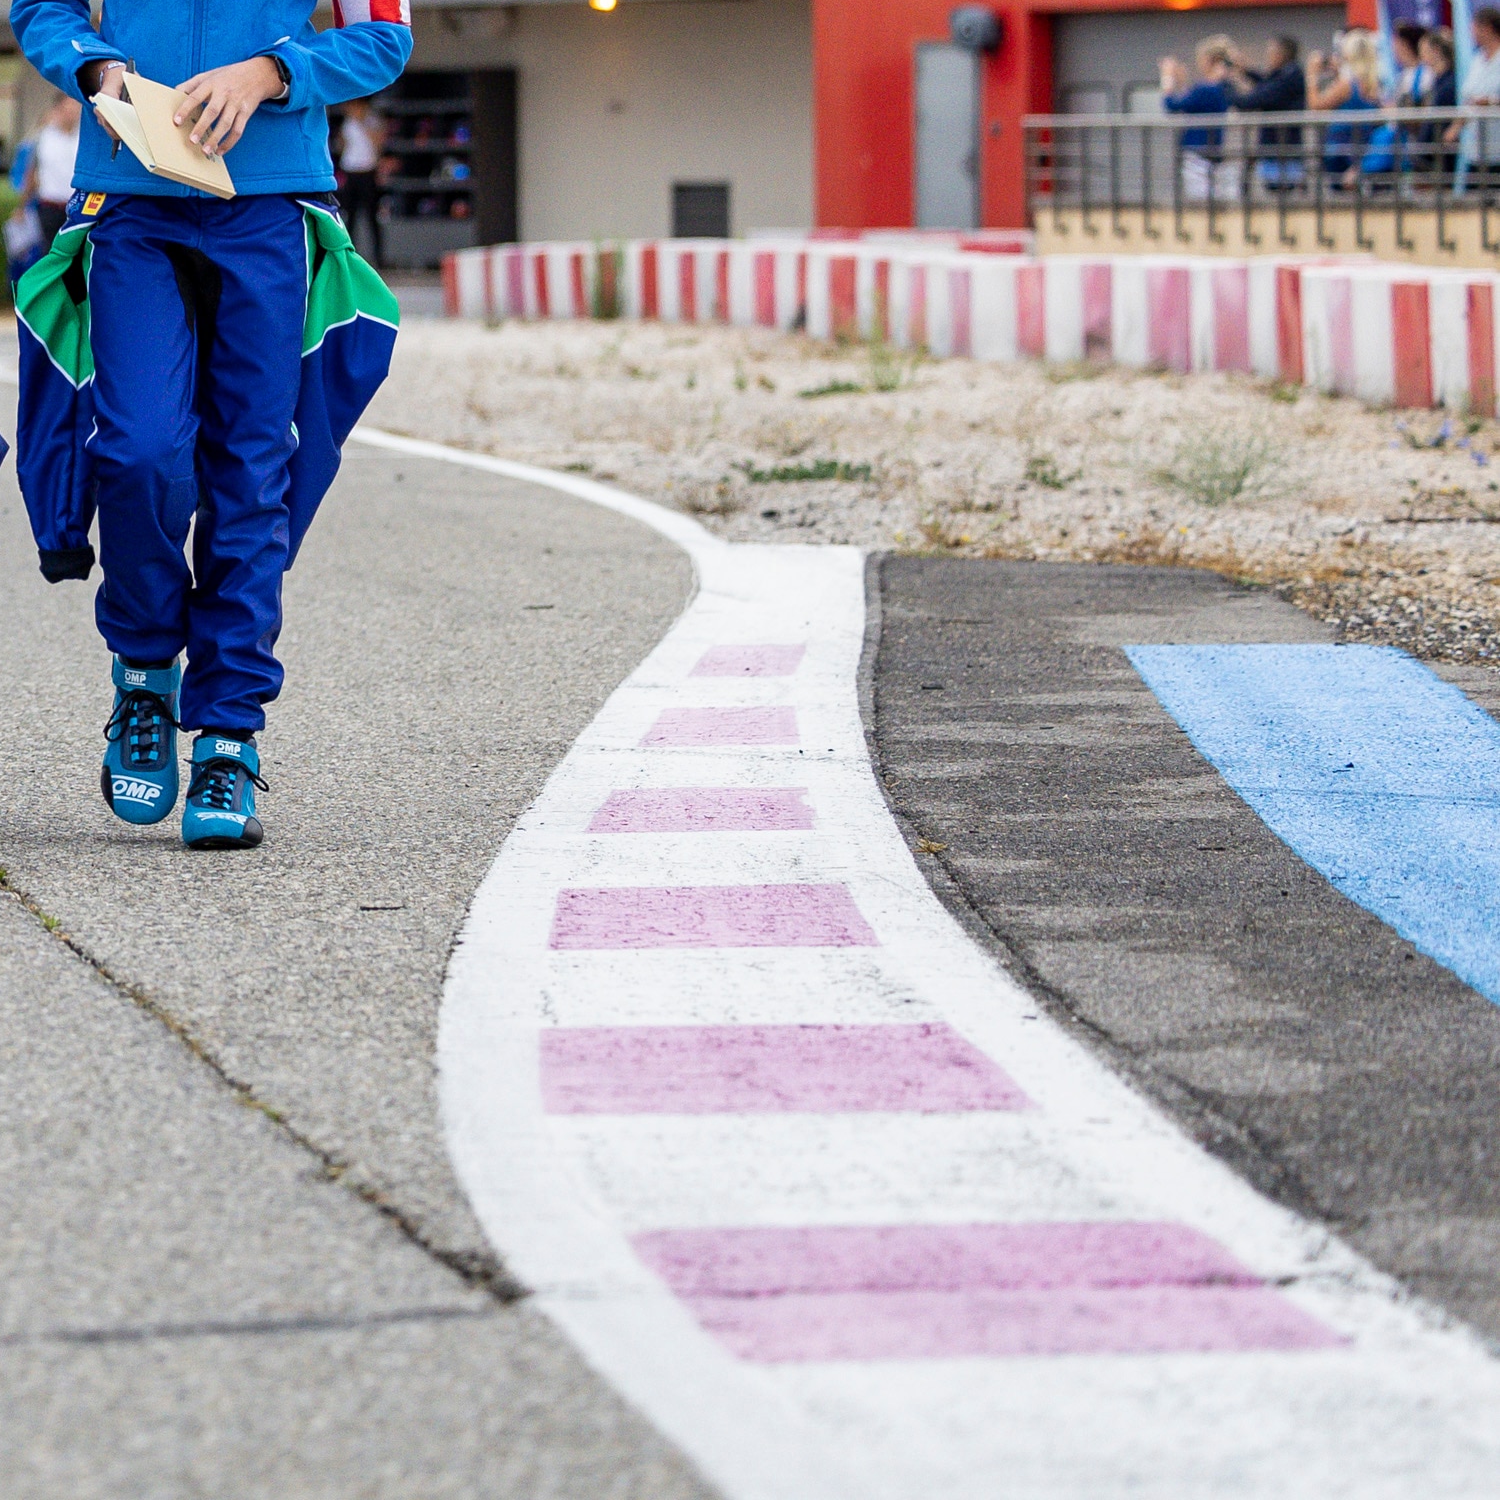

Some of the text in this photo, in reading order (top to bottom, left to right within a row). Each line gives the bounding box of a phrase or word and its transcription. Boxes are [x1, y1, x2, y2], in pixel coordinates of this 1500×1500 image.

[125, 672, 147, 683] OMP
[215, 743, 241, 754] OMP
[113, 780, 161, 800] OMP
